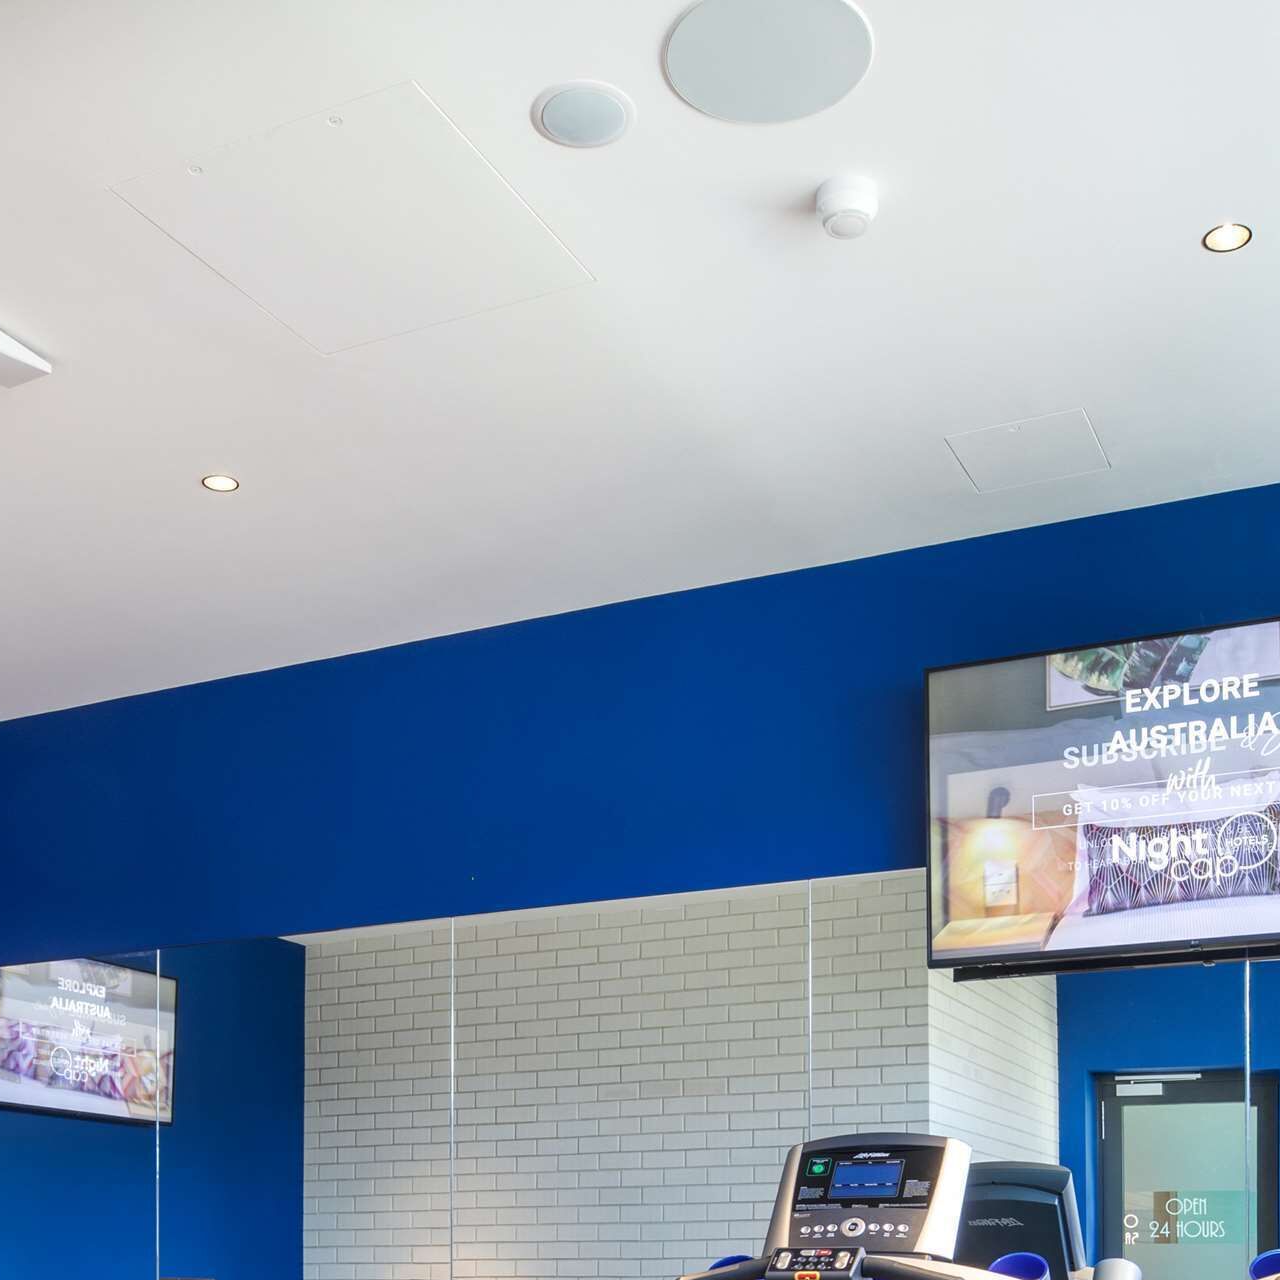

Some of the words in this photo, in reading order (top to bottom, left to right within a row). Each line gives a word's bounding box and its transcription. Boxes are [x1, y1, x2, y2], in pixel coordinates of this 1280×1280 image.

[1125, 673, 1260, 714] EXPLORE
[1106, 711, 1279, 754] AUSTRALIA
[1166, 757, 1216, 796] with
[1063, 801, 1094, 817] GET
[1101, 796, 1133, 812] 10%
[1139, 792, 1171, 808] OFF
[1177, 785, 1223, 803] YOUR
[1229, 780, 1276, 799] NEXT
[1111, 828, 1209, 871] Night
[1225, 834, 1269, 848] HOTELS
[1171, 854, 1239, 886] cap
[1165, 1198, 1207, 1216] OPEN
[1149, 1221, 1170, 1238] 24
[1176, 1220, 1225, 1239] HOURS
